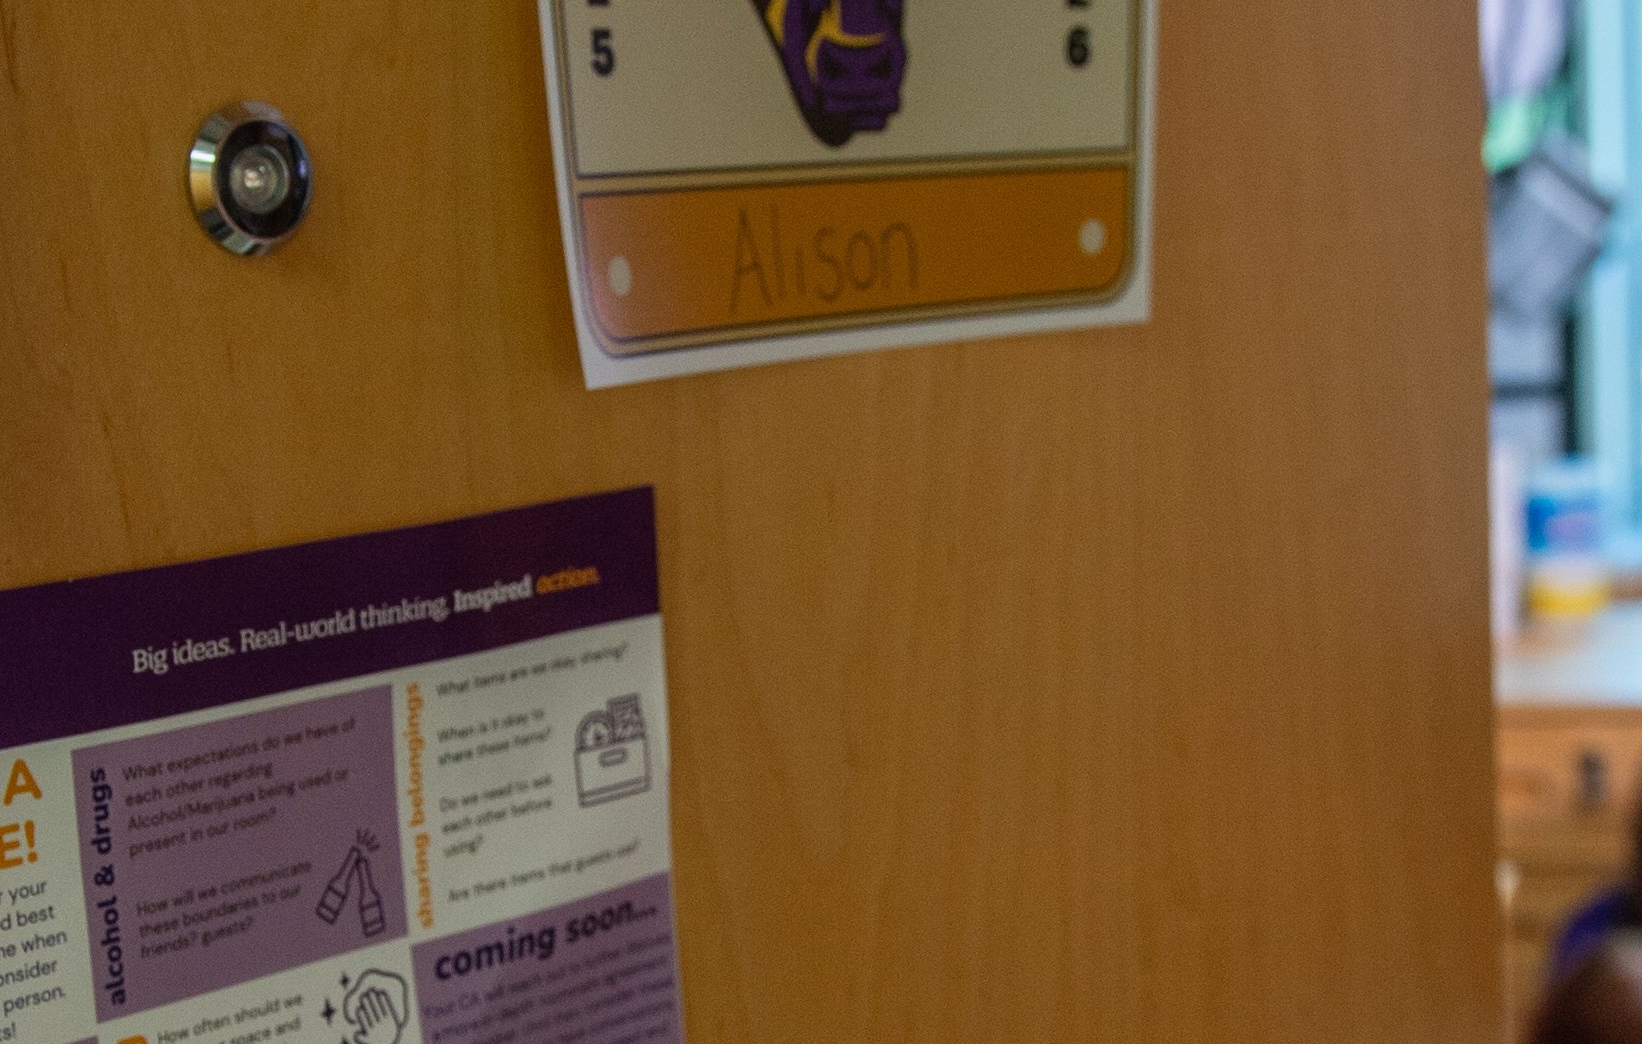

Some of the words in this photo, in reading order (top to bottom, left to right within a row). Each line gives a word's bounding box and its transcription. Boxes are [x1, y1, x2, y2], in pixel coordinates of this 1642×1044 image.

[727, 202, 921, 316] Alison
[130, 645, 169, 675] Big
[170, 636, 235, 665] ideas.
[238, 607, 357, 653] Real-world
[358, 595, 450, 630] thinking.
[452, 572, 533, 613] Inspired
[121, 761, 163, 782] What
[165, 740, 260, 773] expectations
[261, 735, 281, 752] do
[282, 731, 303, 746] we
[304, 723, 339, 740] have
[340, 715, 356, 733] of
[404, 681, 426, 829] belongings
[1, 758, 42, 806] A
[123, 786, 163, 807] each
[165, 778, 205, 799] other
[207, 761, 273, 790] regarding
[256, 780, 296, 801] being
[297, 769, 332, 791] used
[333, 768, 349, 782] or
[88, 766, 113, 856] drugs
[127, 830, 186, 859] present
[189, 828, 204, 842] in
[205, 821, 230, 839] our
[231, 805, 277, 831] room?
[6, 879, 47, 906] your
[92, 863, 115, 887] &
[413, 831, 434, 928] sharing
[14, 904, 55, 928] best
[19, 930, 68, 954] when
[95, 894, 127, 1005] alcohol
[433, 924, 557, 982] coming
[1, 985, 66, 1018] person.
[156, 1027, 190, 1044] How
[191, 1015, 231, 1037] often
[232, 997, 281, 1024] should
[282, 993, 303, 1009] we
[274, 1016, 301, 1036] and
